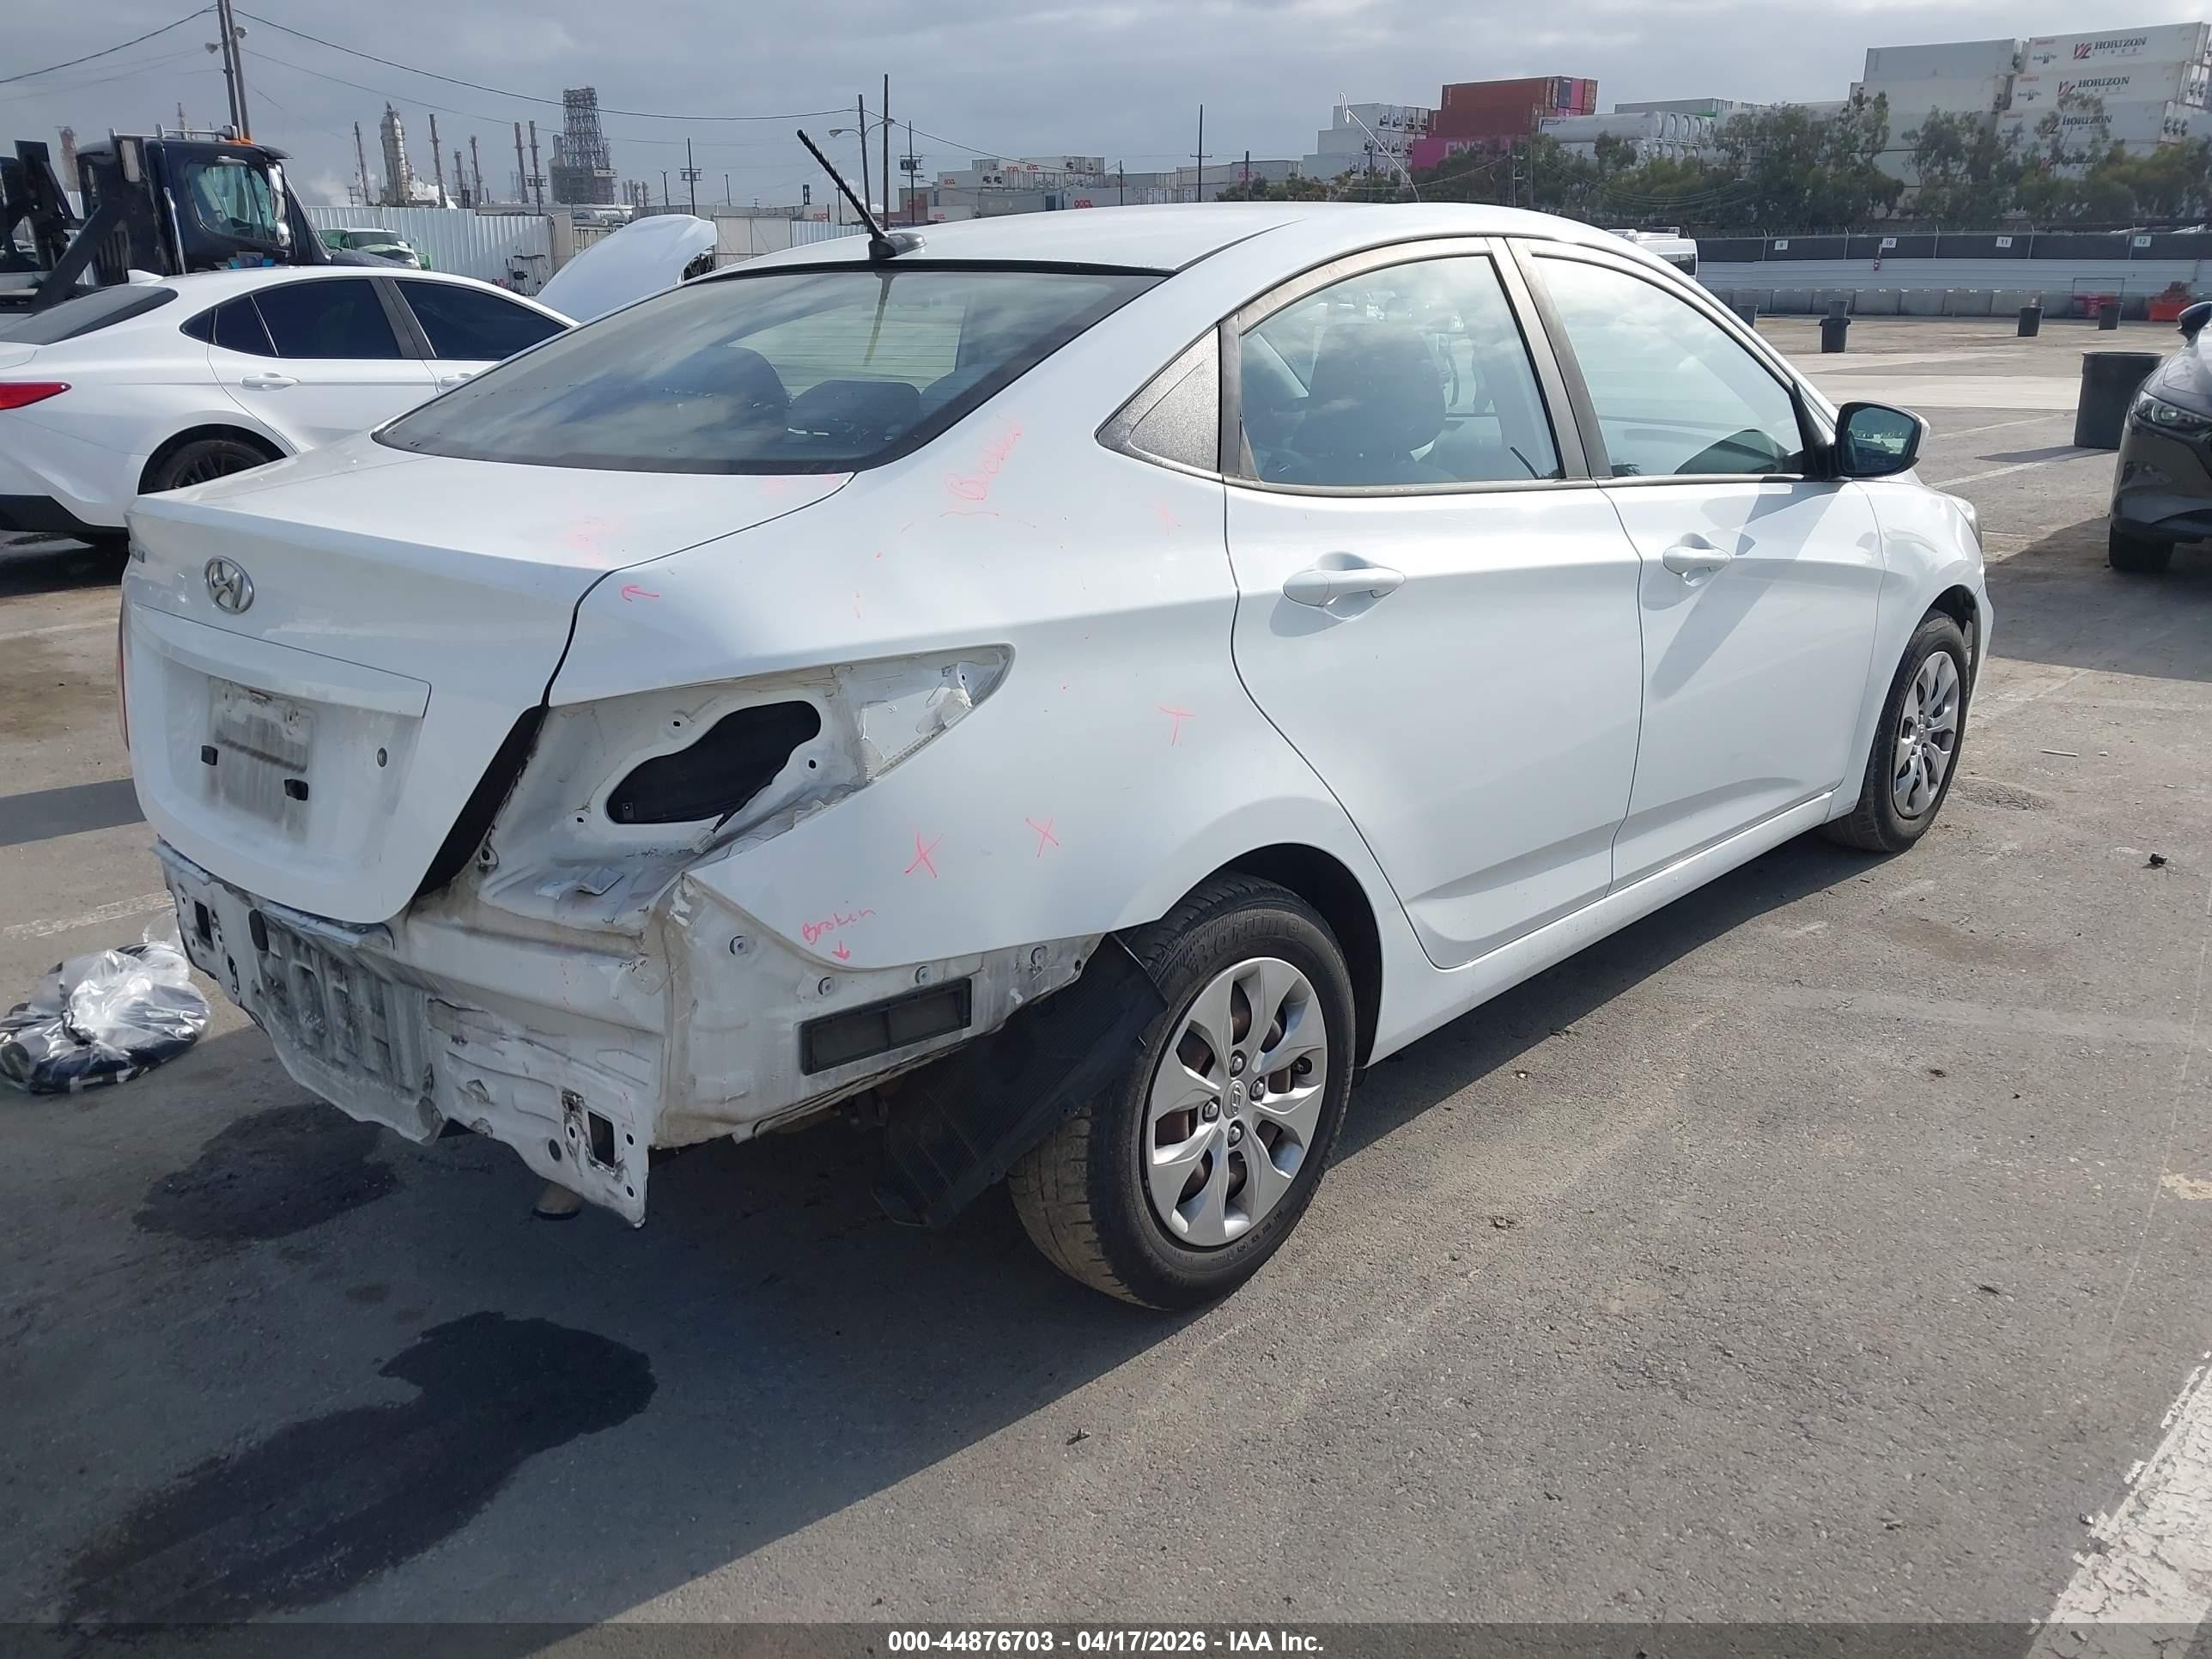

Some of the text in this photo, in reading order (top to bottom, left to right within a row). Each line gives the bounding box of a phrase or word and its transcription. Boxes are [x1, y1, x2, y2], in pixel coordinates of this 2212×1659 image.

[2094, 37, 2148, 50] HORIZON
[2077, 76, 2130, 88] HORIZON
[801, 906, 876, 945] Broken
